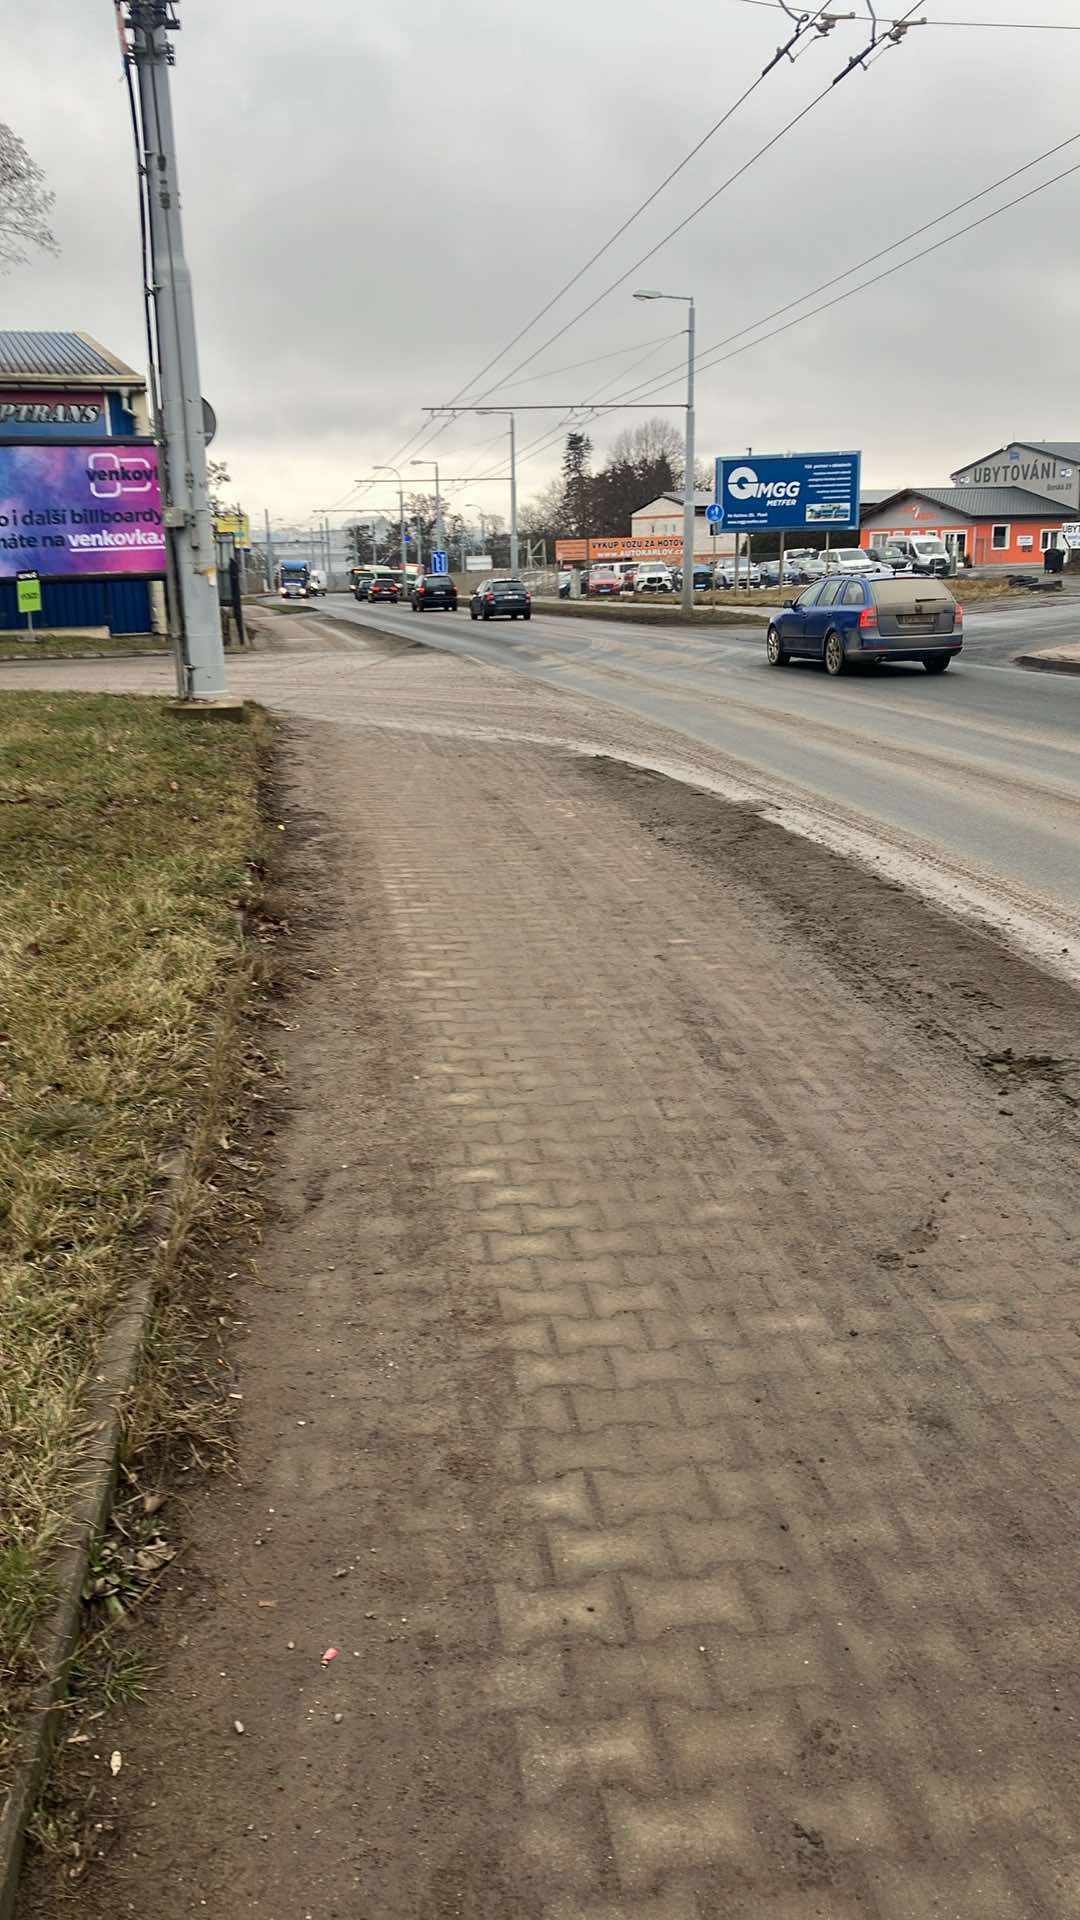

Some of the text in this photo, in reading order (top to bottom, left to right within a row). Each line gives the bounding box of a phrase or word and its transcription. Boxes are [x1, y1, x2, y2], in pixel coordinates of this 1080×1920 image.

[0, 403, 100, 423] PTRANS
[766, 499, 797, 507] METFER
[12, 509, 17, 526] i
[21, 508, 66, 526] další
[71, 508, 162, 526] billboardy
[41, 535, 65, 548] na
[592, 541, 618, 549] VYKUP
[645, 540, 656, 548] ZA
